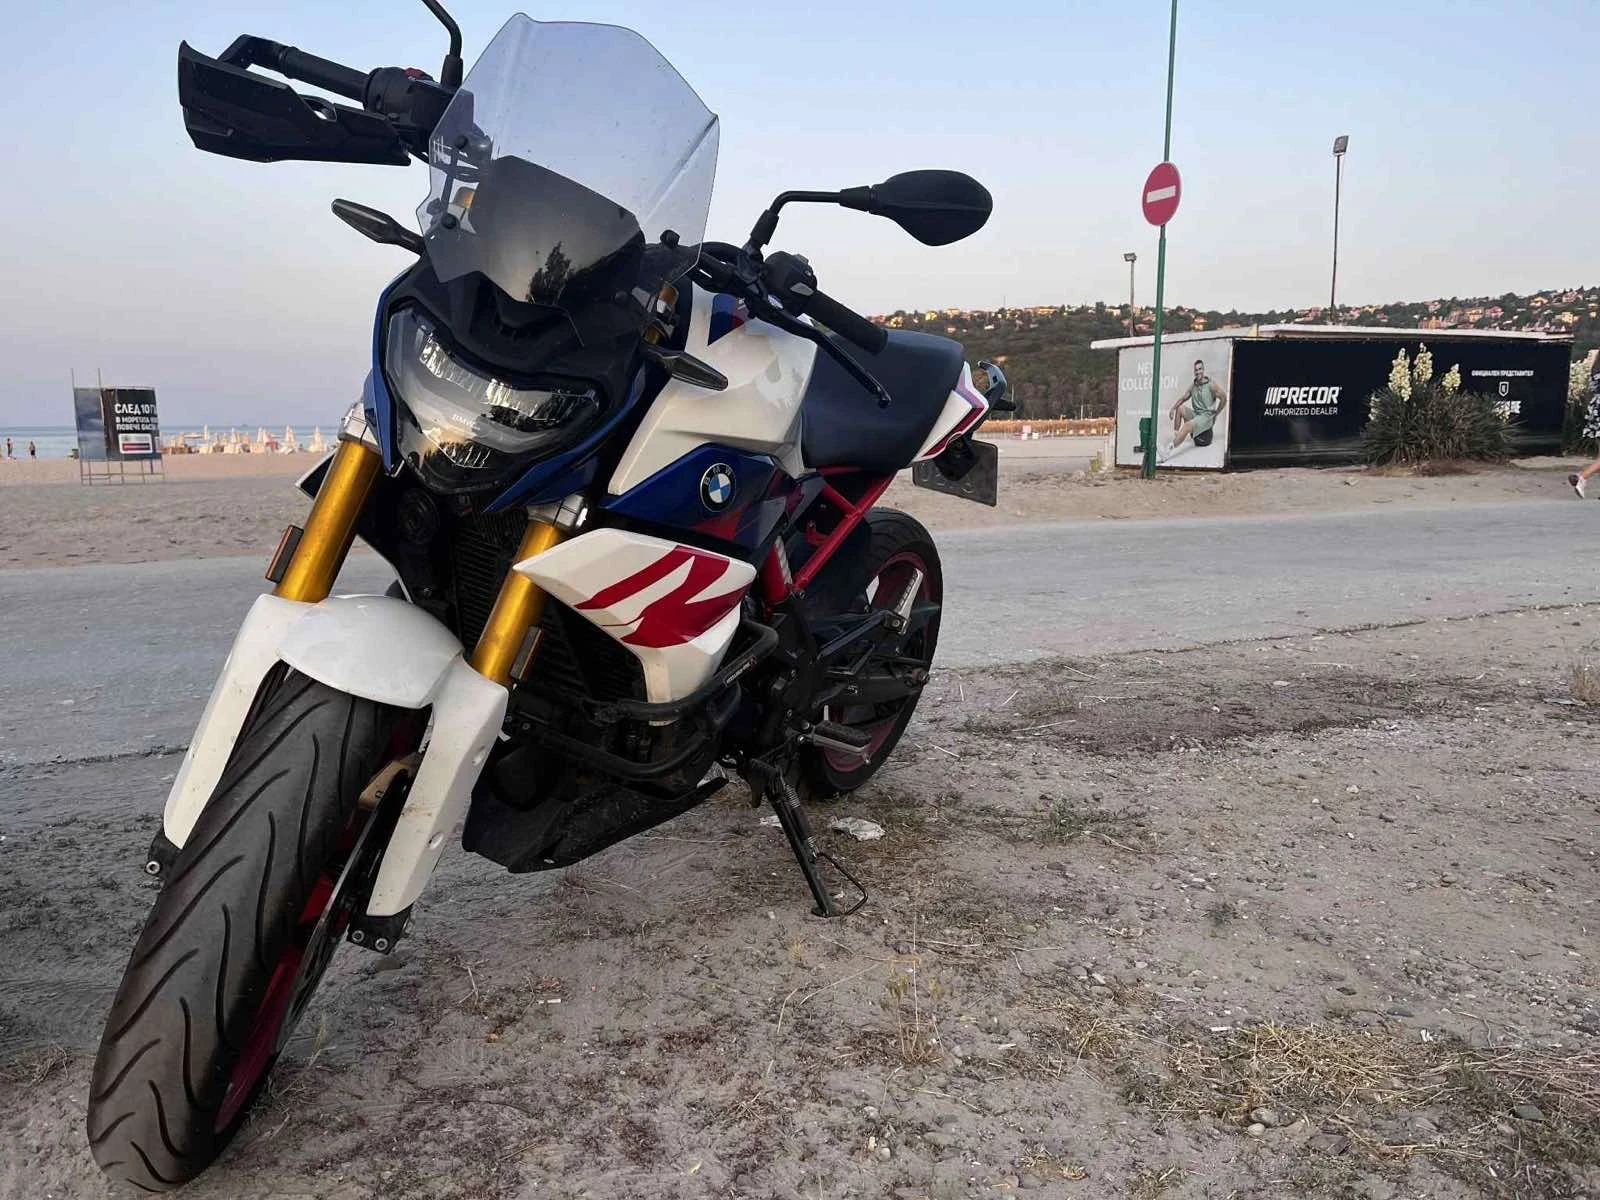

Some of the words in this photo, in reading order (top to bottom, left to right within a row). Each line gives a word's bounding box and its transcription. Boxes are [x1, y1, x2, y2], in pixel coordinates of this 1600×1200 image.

[1275, 386, 1340, 405] PRECOR
[115, 403, 141, 415] СЛЕД
[141, 404, 150, 414] 10
[1264, 408, 1310, 416] AUTHORIZED
[1310, 407, 1338, 416] DEALER
[703, 465, 733, 486] BMW
